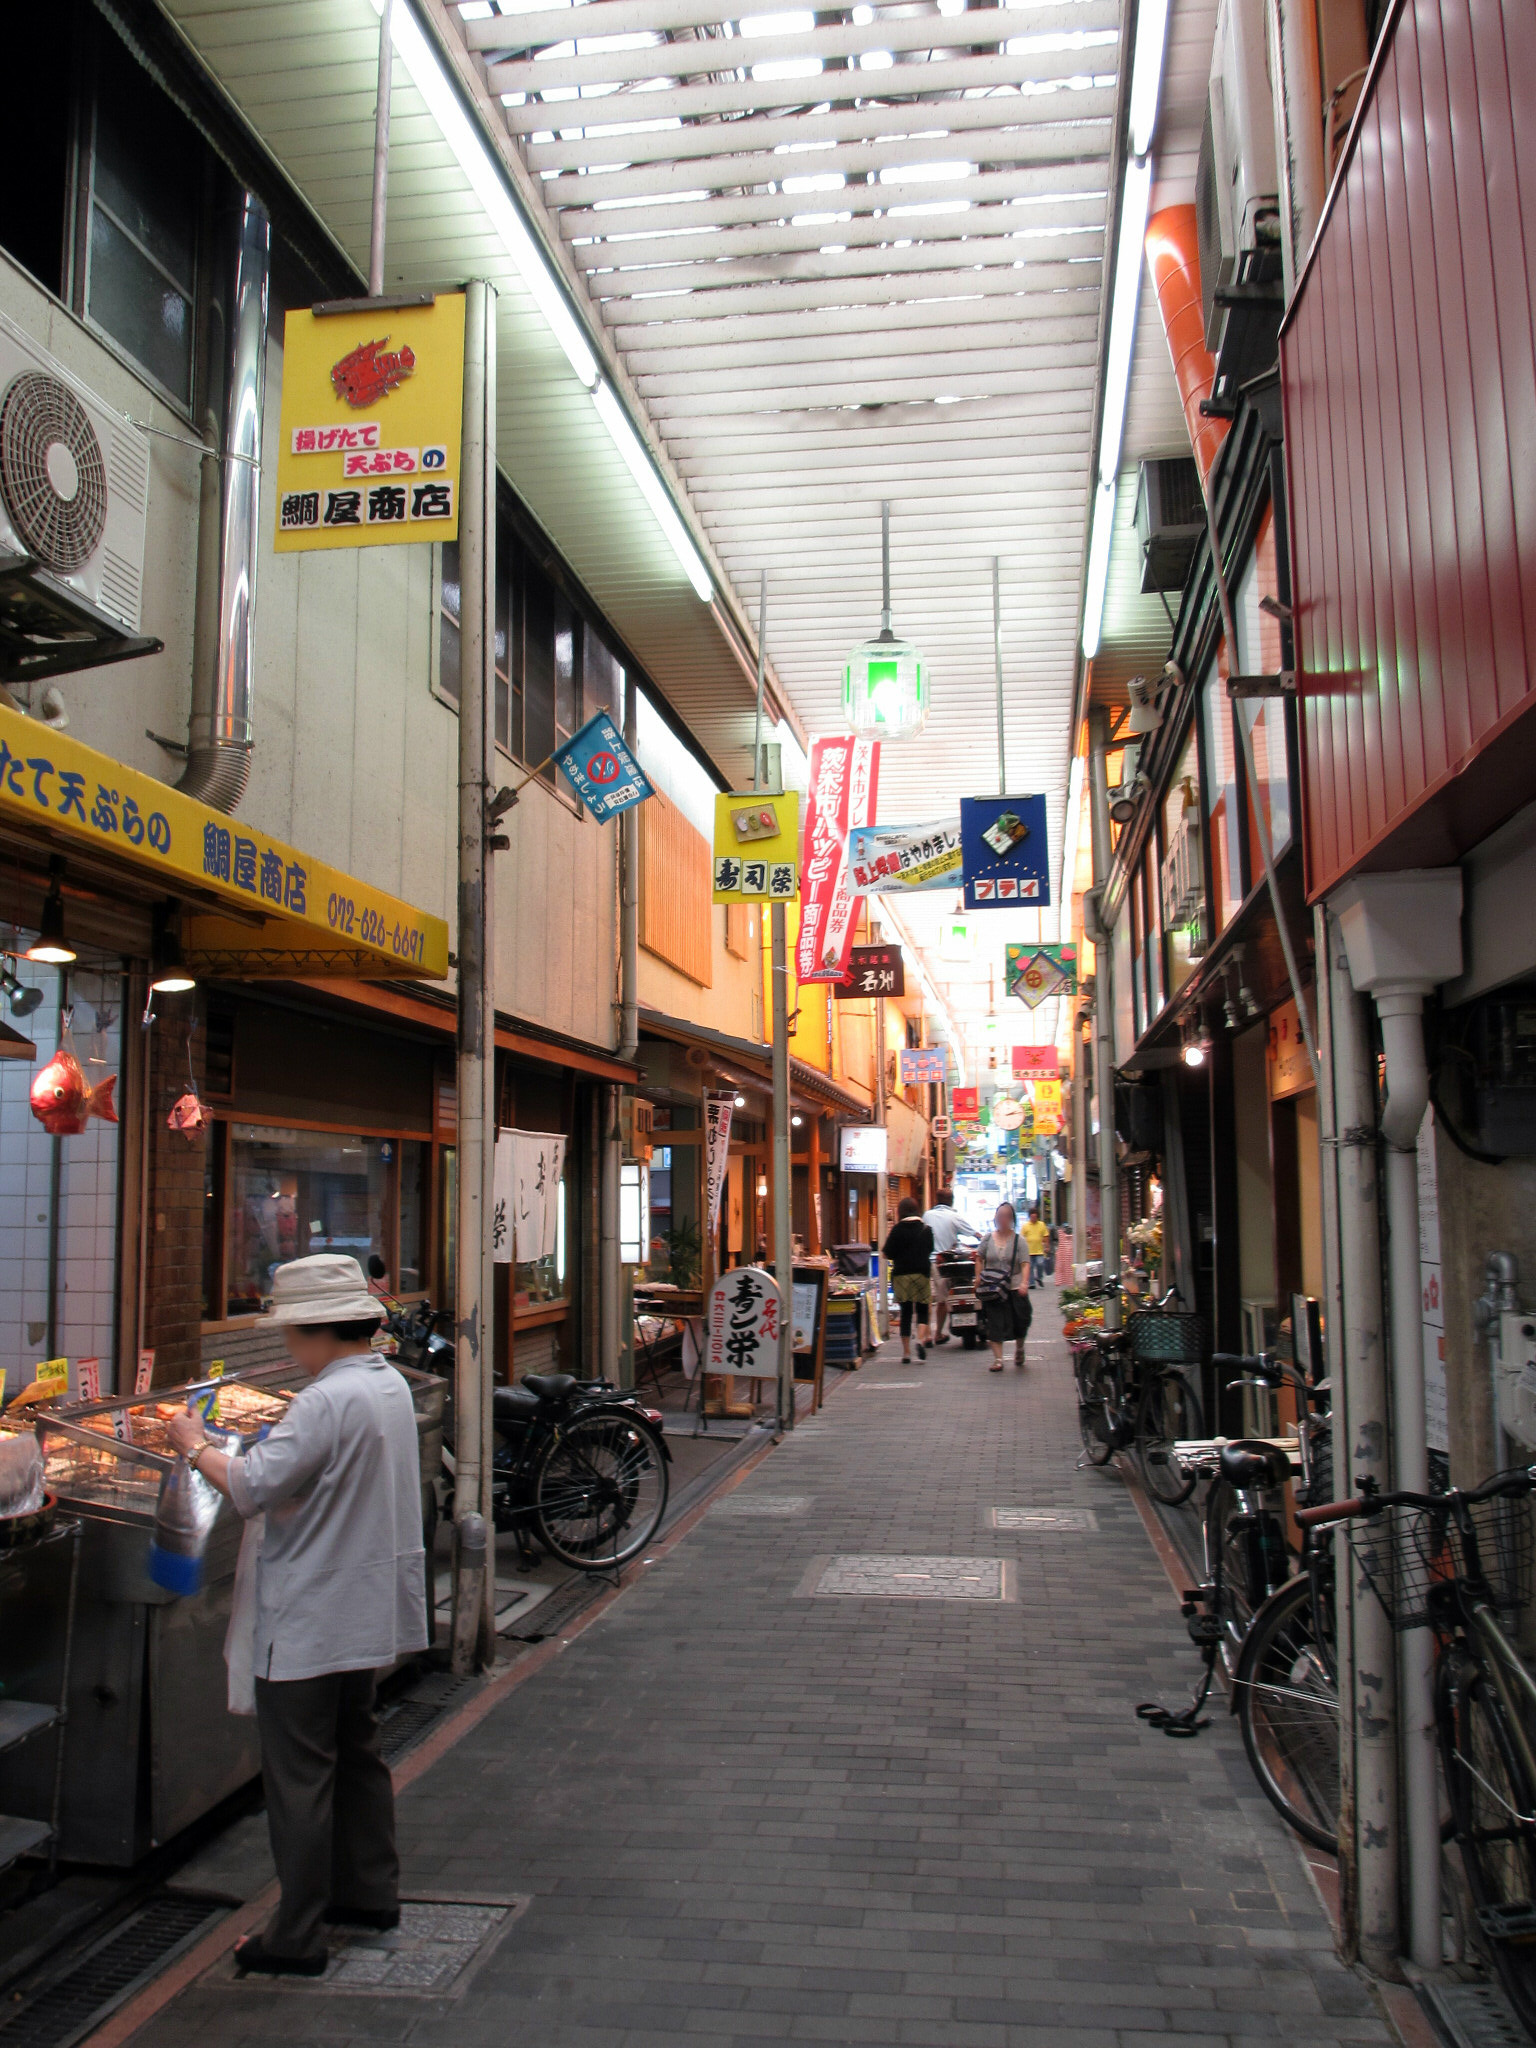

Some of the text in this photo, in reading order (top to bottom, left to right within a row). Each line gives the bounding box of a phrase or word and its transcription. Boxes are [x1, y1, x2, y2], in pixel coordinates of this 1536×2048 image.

[295, 426, 378, 452] 揚げたて
[281, 484, 452, 526] 鯛屋商店
[562, 754, 606, 814] やめましょう
[202, 820, 308, 916] 鯛屋商店
[798, 747, 848, 979] 茨木市ハッピー商品券
[327, 892, 425, 964] 072-626-6691
[758, 1298, 779, 1341] 名代
